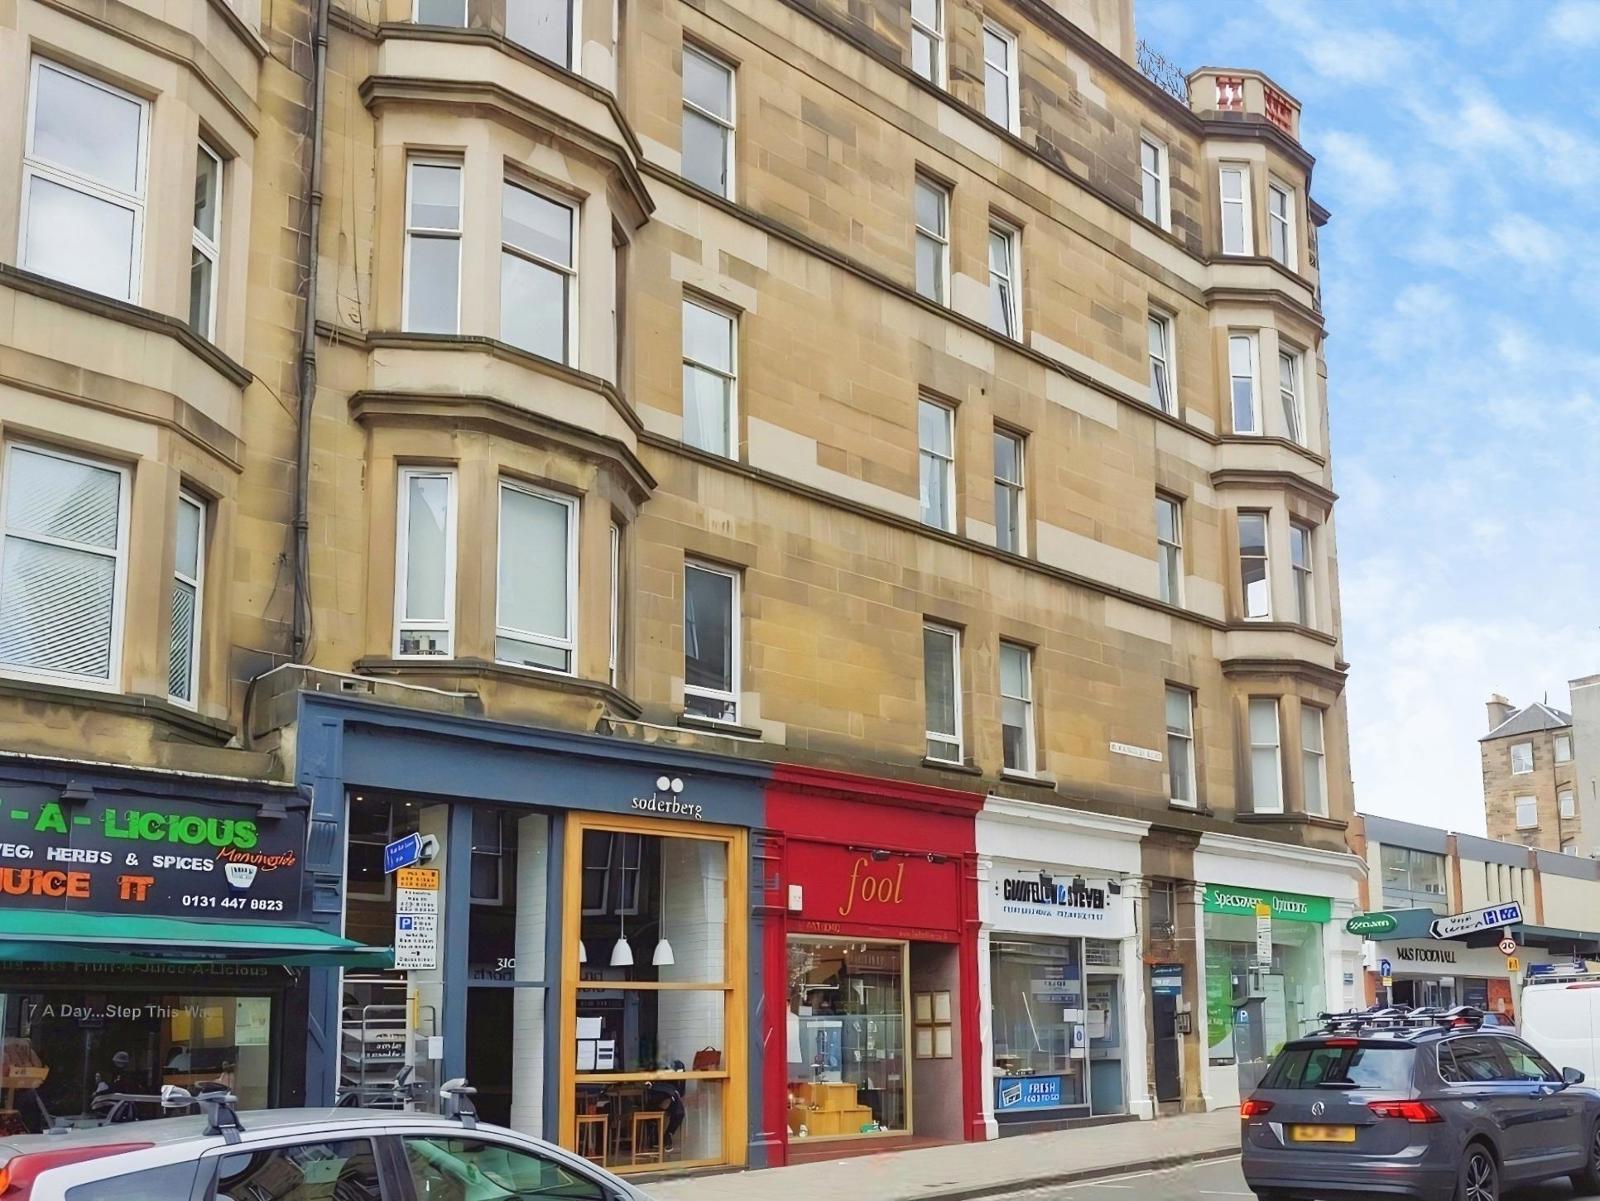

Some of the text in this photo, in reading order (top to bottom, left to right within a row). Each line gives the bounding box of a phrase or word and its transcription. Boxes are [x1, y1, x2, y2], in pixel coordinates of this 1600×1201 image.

[47, 847, 112, 864] HERBS
[125, 853, 139, 866] &
[152, 855, 214, 872] SPICES
[118, 875, 155, 901] IT
[839, 857, 904, 915] fool
[182, 895, 216, 907] 0131
[221, 897, 246, 909] 447
[144, 1005, 179, 1018] This
